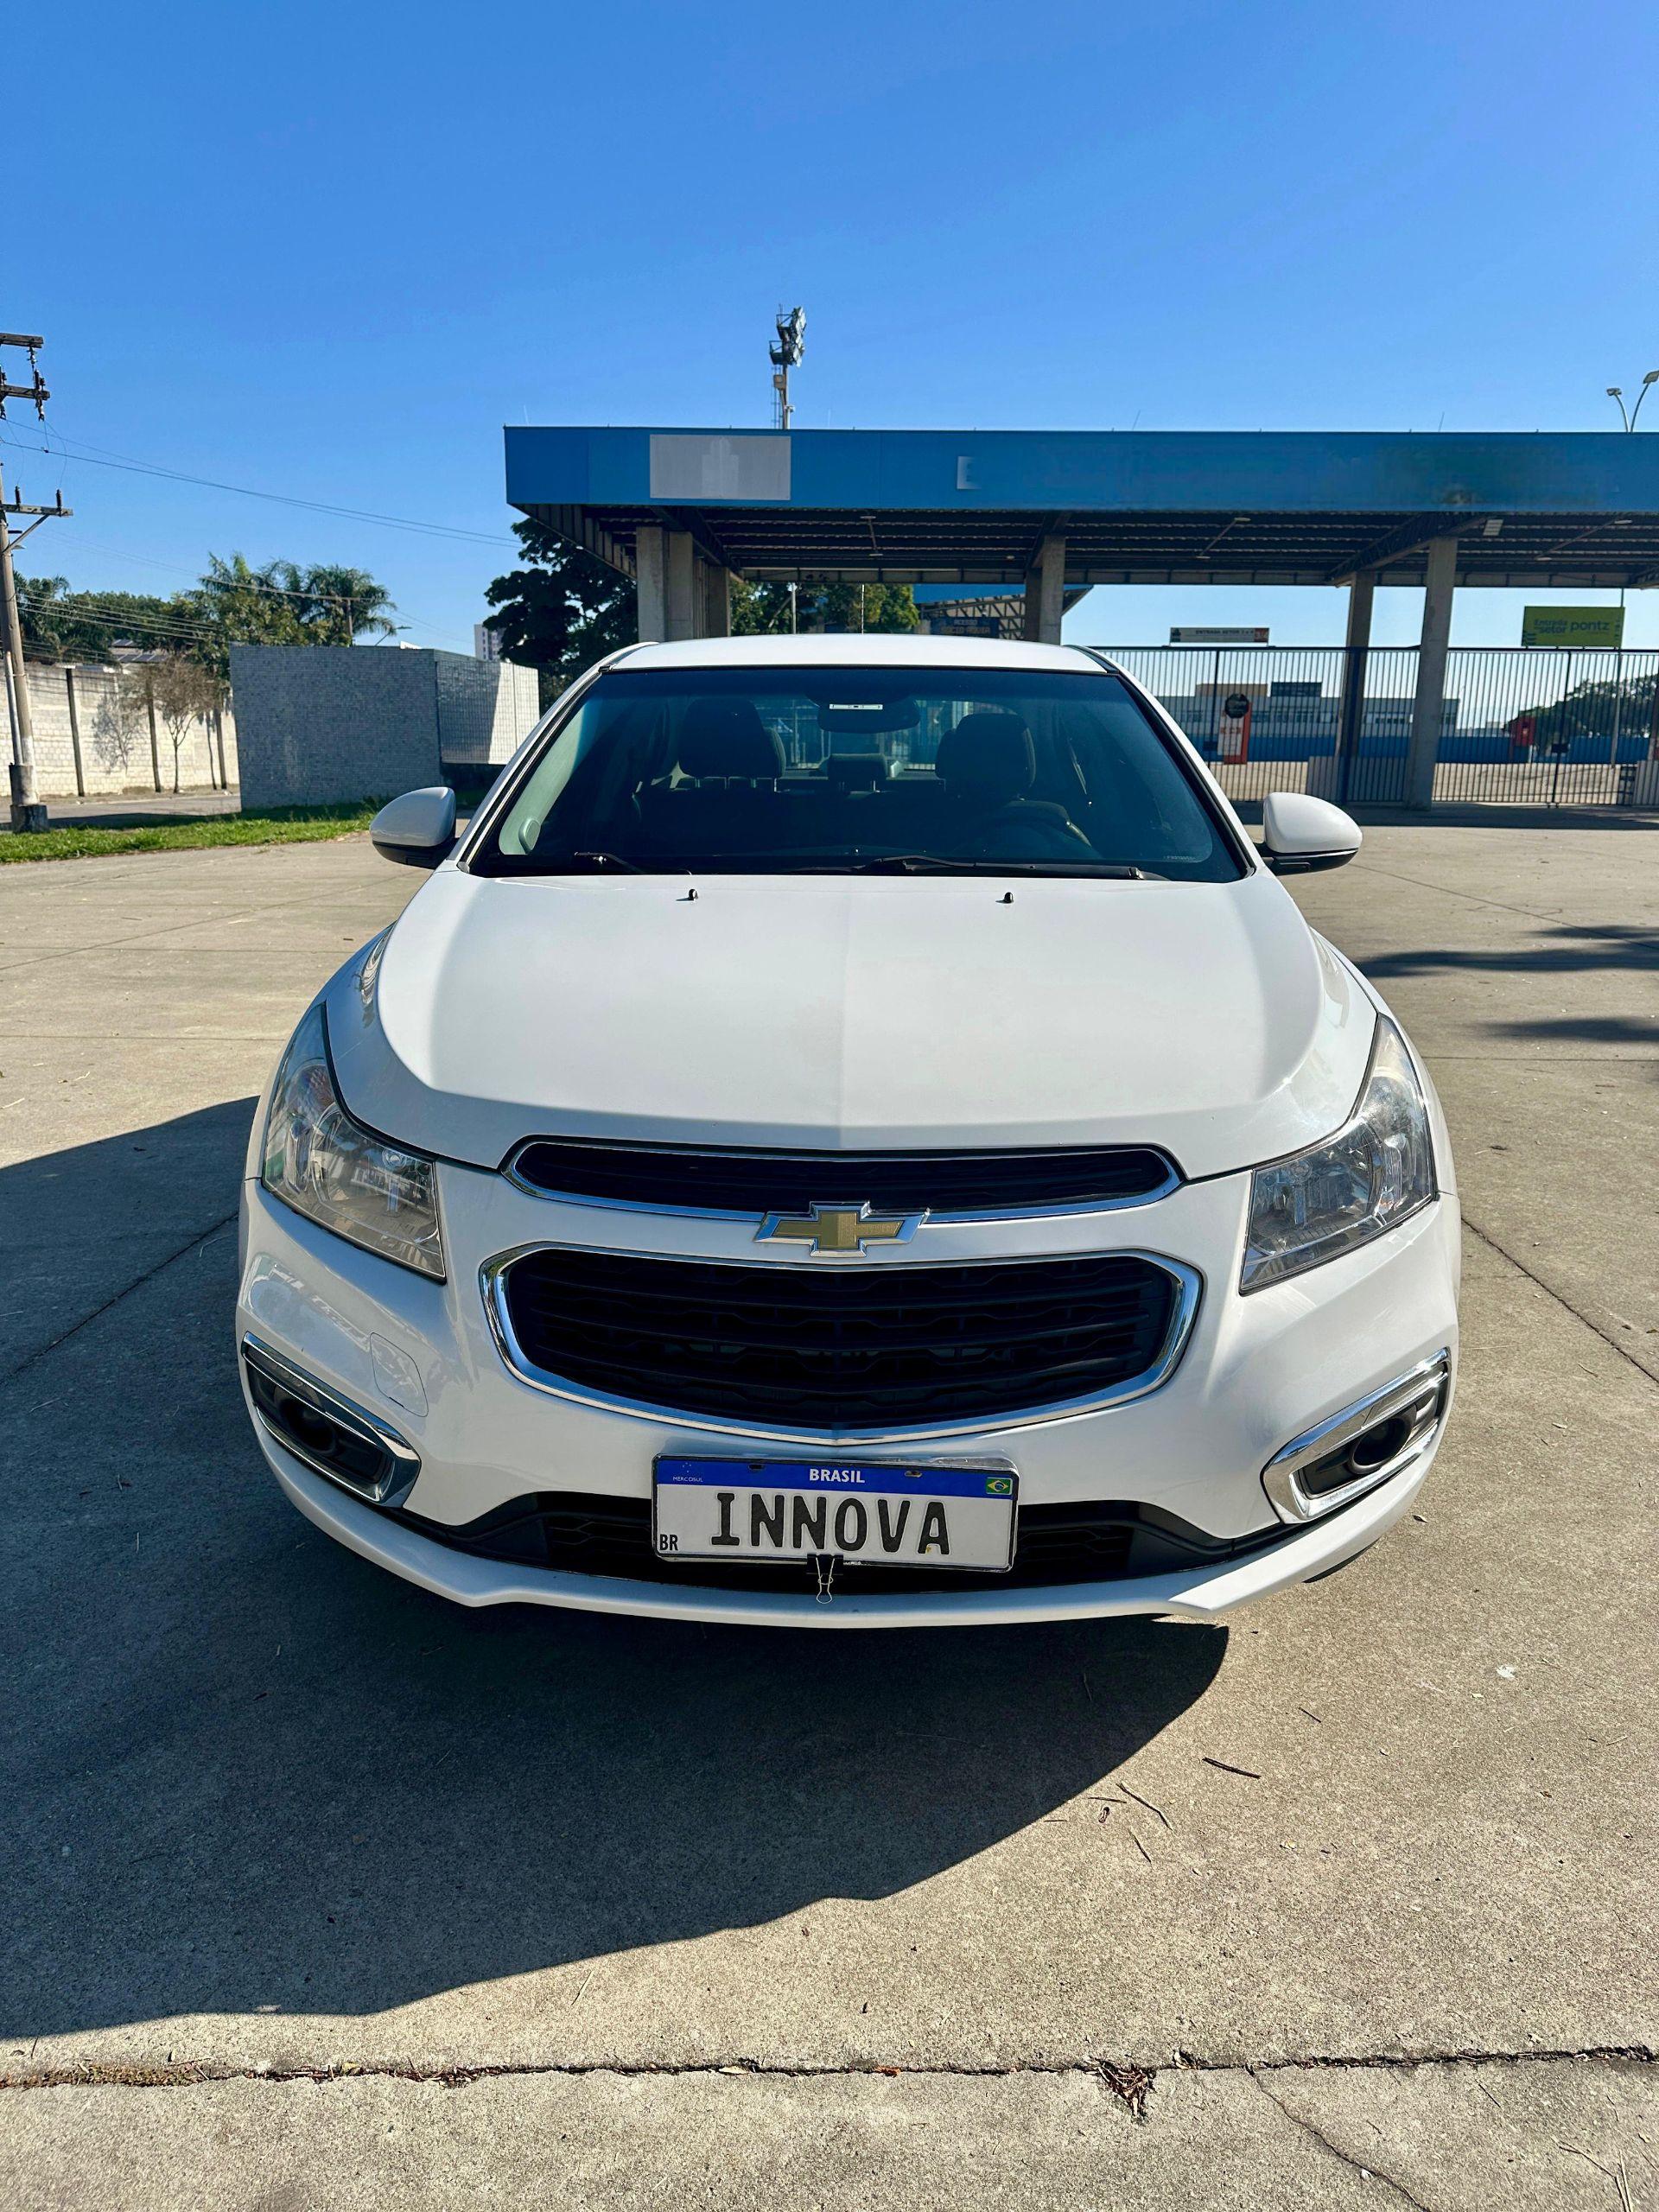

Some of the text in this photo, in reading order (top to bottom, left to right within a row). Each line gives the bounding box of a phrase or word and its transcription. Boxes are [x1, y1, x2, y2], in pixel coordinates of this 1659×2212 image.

[1570, 620, 1610, 632] pontz
[809, 1468, 865, 1484] BRASIL
[710, 1492, 951, 1554] INNOVA
[659, 1534, 679, 1552] BR
